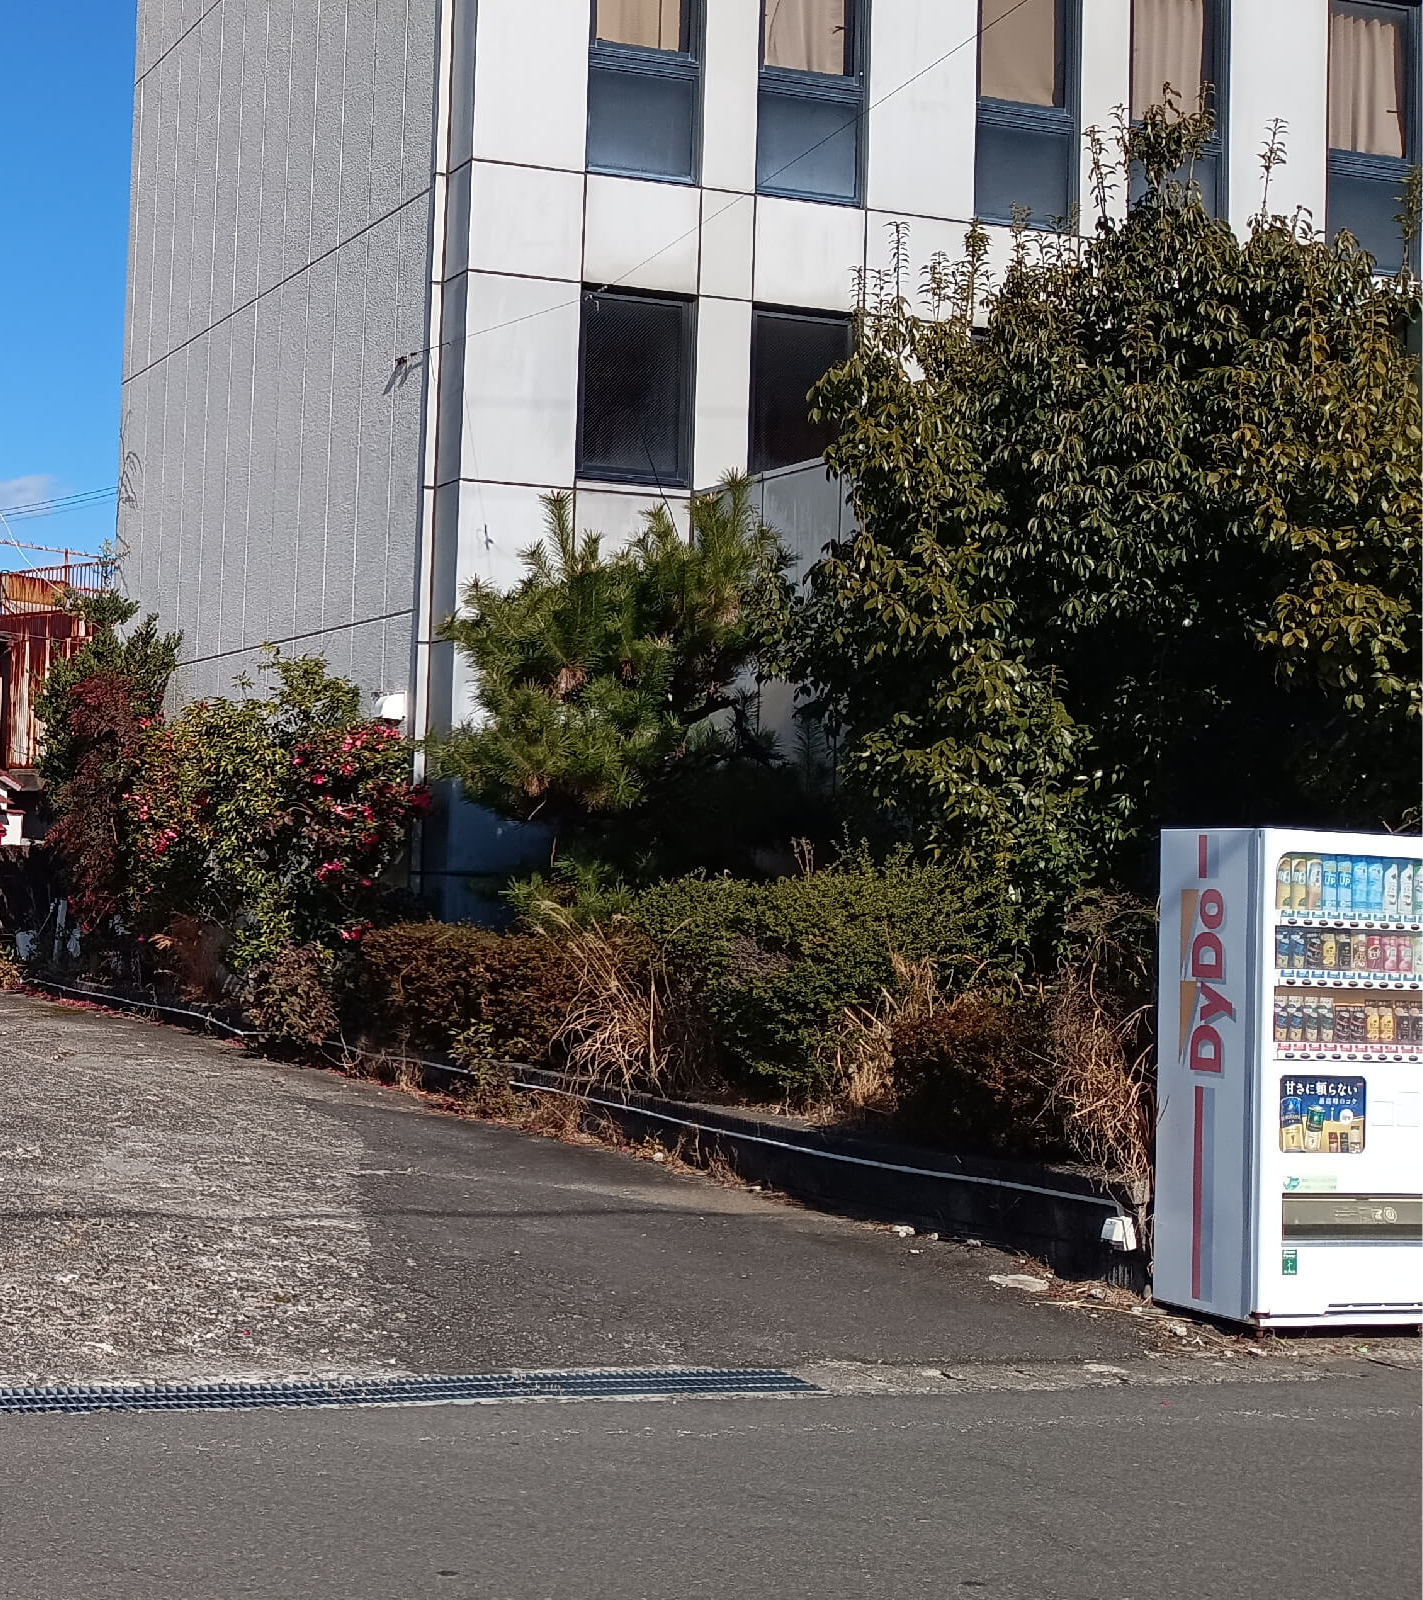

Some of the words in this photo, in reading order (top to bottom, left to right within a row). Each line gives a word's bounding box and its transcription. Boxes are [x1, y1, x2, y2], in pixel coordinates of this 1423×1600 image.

[1285, 1080, 1358, 1096] 甘さに頼らない
